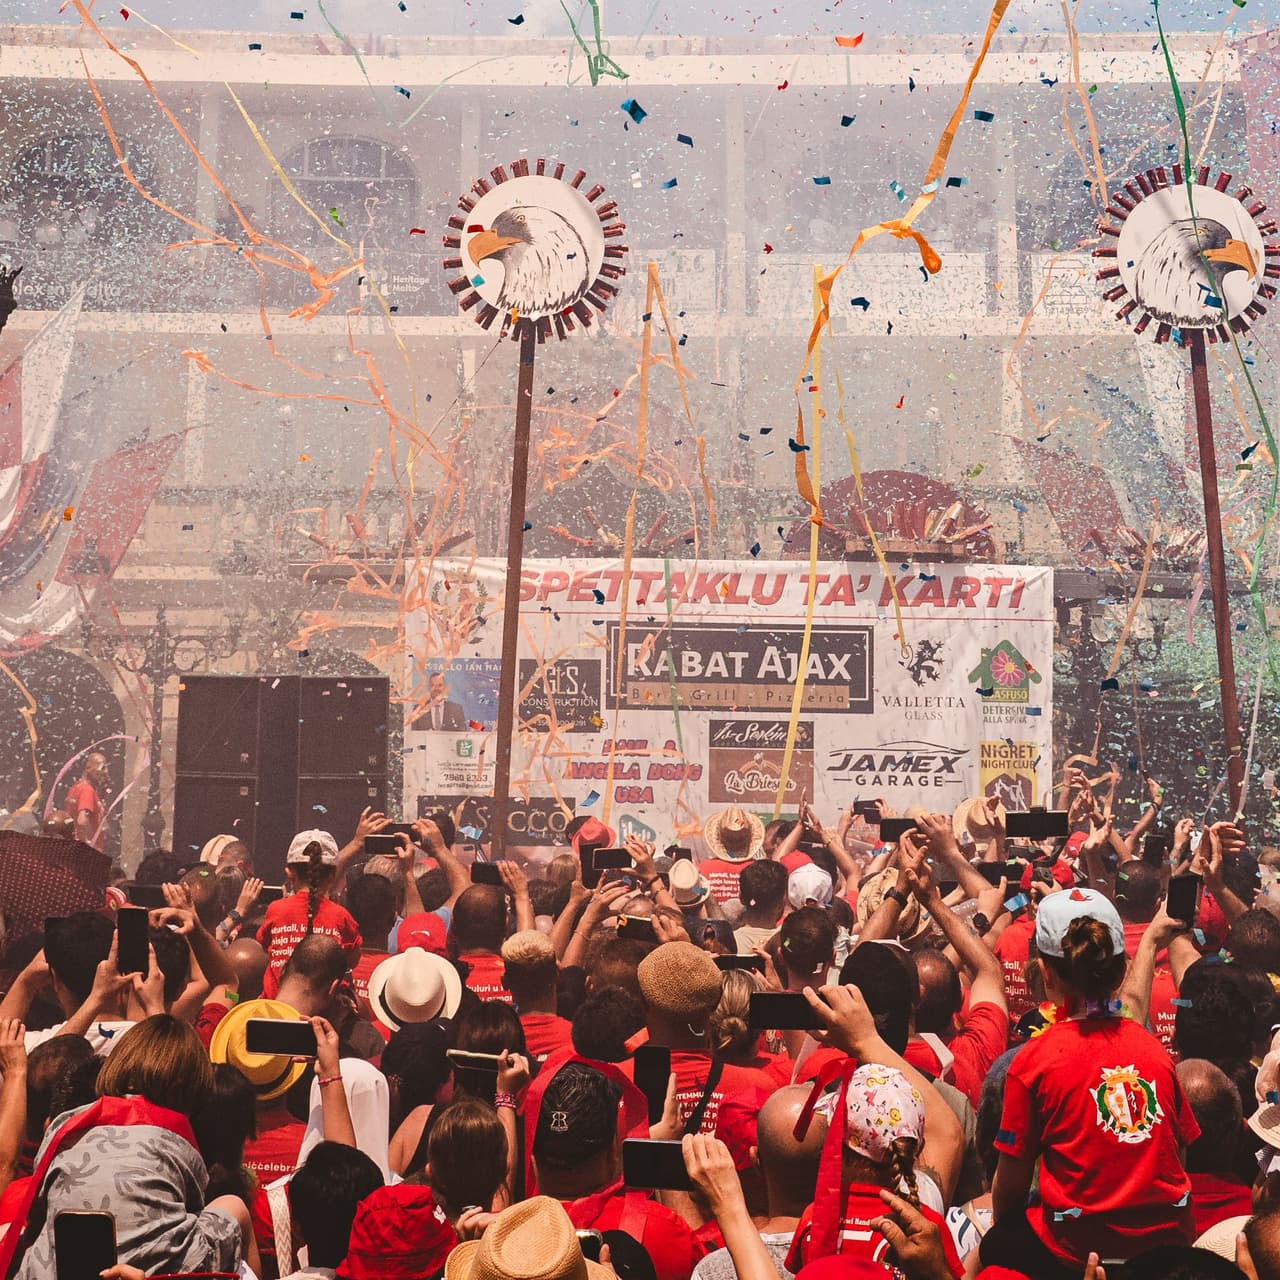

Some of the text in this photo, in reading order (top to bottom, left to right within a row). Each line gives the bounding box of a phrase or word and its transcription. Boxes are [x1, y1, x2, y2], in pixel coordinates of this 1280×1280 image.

[392, 275, 430, 287] Heritage
[392, 284, 418, 293] Malta
[518, 569, 1026, 609] SPETTAKLU TA' KARTI
[465, 662, 482, 672] IAN
[626, 642, 853, 683] RABAT AJAX
[521, 697, 599, 707] CONSRUCTION
[631, 688, 845, 704] Br Grill Pizeria
[881, 695, 966, 708] VALLETTA
[904, 710, 944, 721] GLASS
[826, 751, 963, 773] JAMEX
[980, 758, 1011, 769] NIGHT
[855, 774, 944, 788] GARAGE
[614, 785, 655, 804] USA
